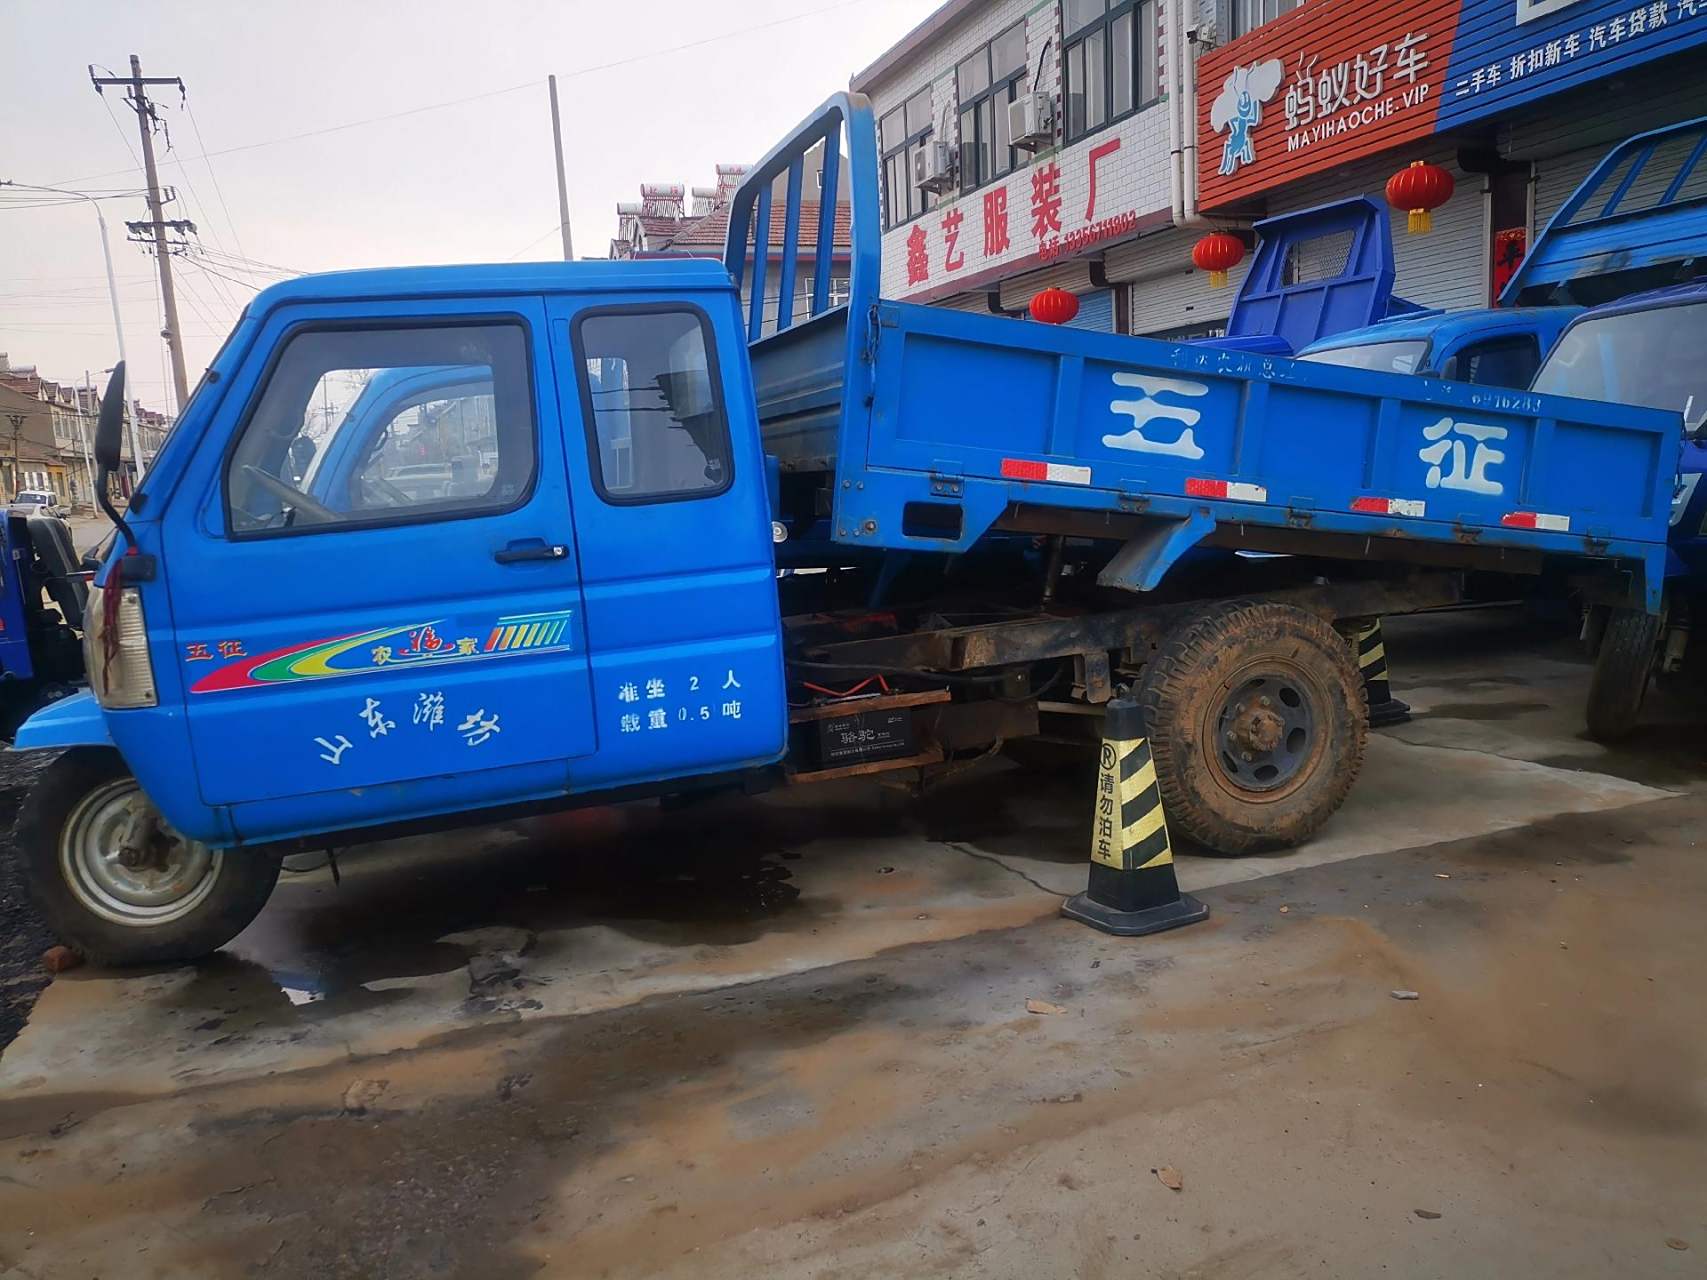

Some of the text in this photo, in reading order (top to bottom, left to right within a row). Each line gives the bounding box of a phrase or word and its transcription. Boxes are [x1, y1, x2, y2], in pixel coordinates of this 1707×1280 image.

[1455, 63, 1502, 97] 二手车
[1510, 33, 1580, 80] 折扣新车
[1589, 1, 1669, 51] 汽车贷款
[1678, 0, 1707, 20] 汽
[1284, 32, 1430, 131] 蚂蚁好车
[906, 137, 1121, 287] 鑫艺服装厂
[185, 639, 248, 663] 五征
[688, 675, 700, 692] 2
[722, 669, 741, 690] 人
[620, 700, 742, 733] 载重 0.5 吨
[841, 728, 876, 744] 骆驼
[1097, 772, 1115, 860] 请勿泊车
